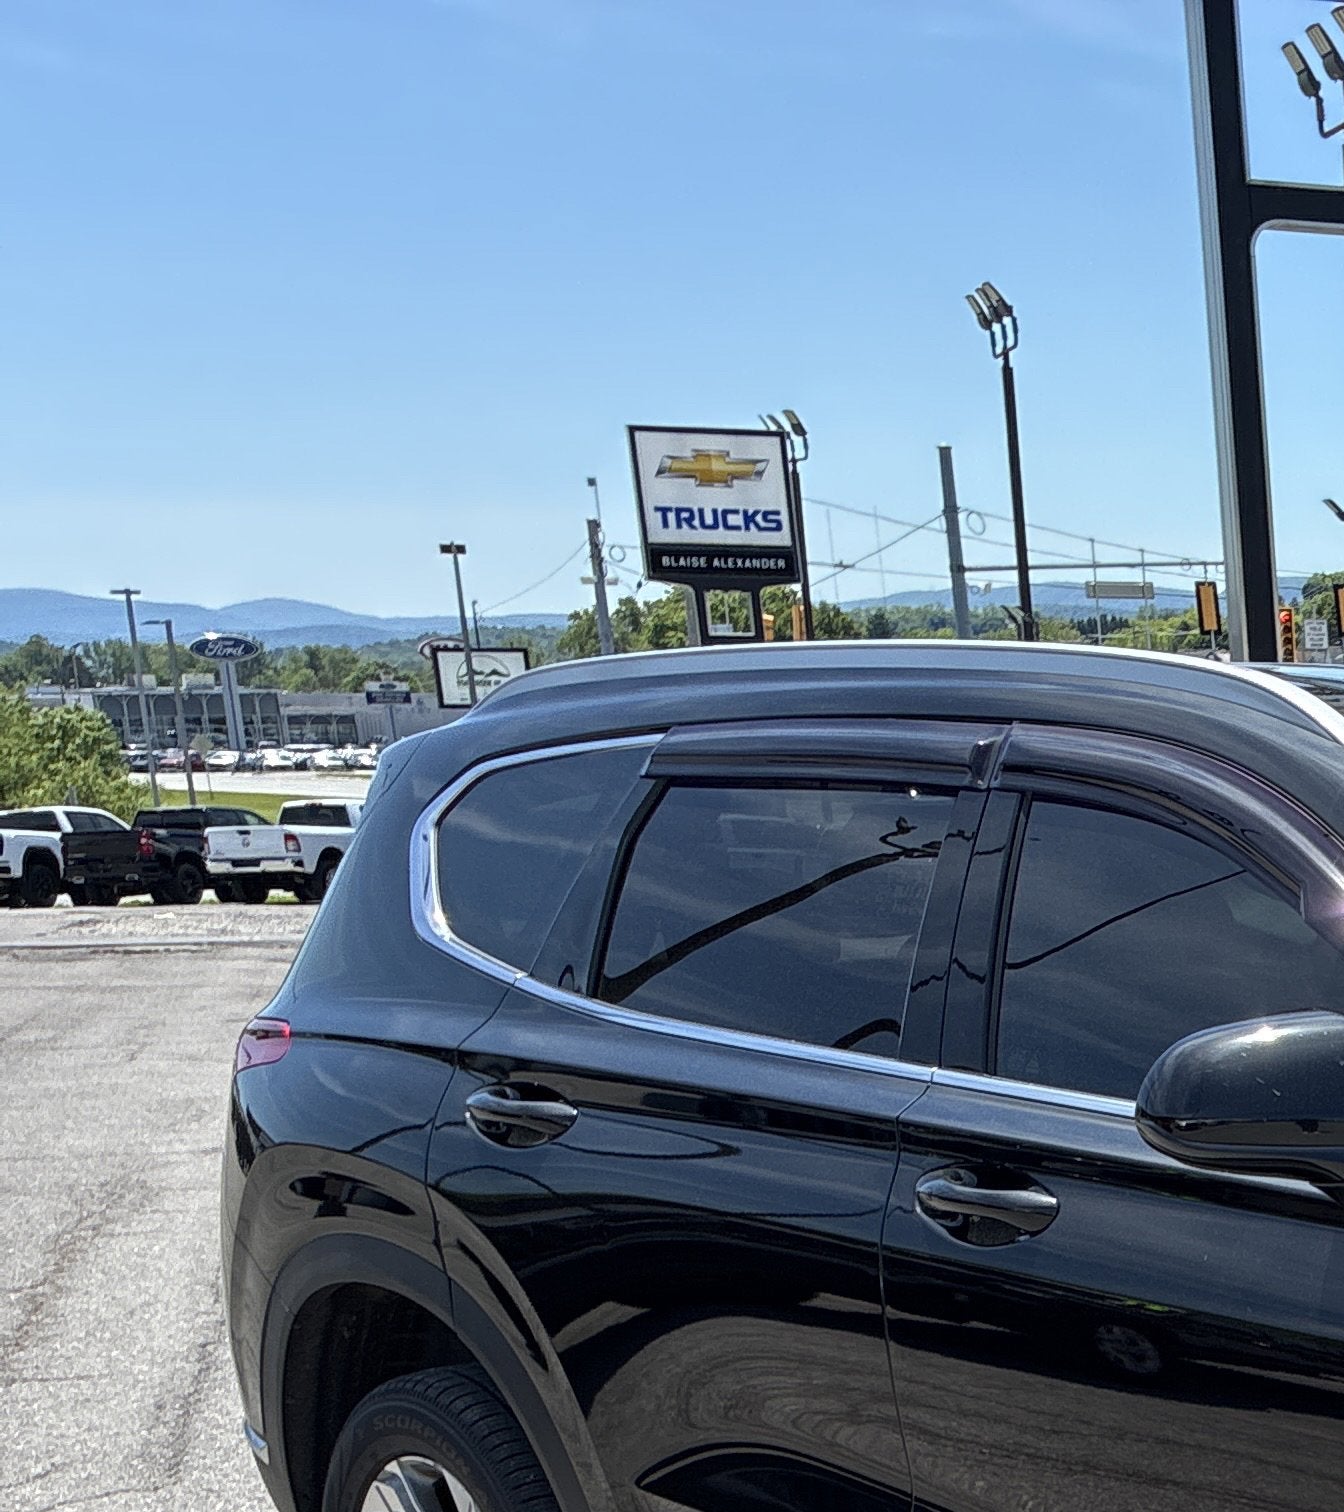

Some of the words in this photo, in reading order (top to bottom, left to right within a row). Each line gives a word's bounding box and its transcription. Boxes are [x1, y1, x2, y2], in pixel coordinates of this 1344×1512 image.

[654, 505, 783, 532] TRUCKS
[661, 555, 707, 568] BLAISE
[712, 556, 786, 570] ALEXANDER
[204, 639, 245, 657] Ford
